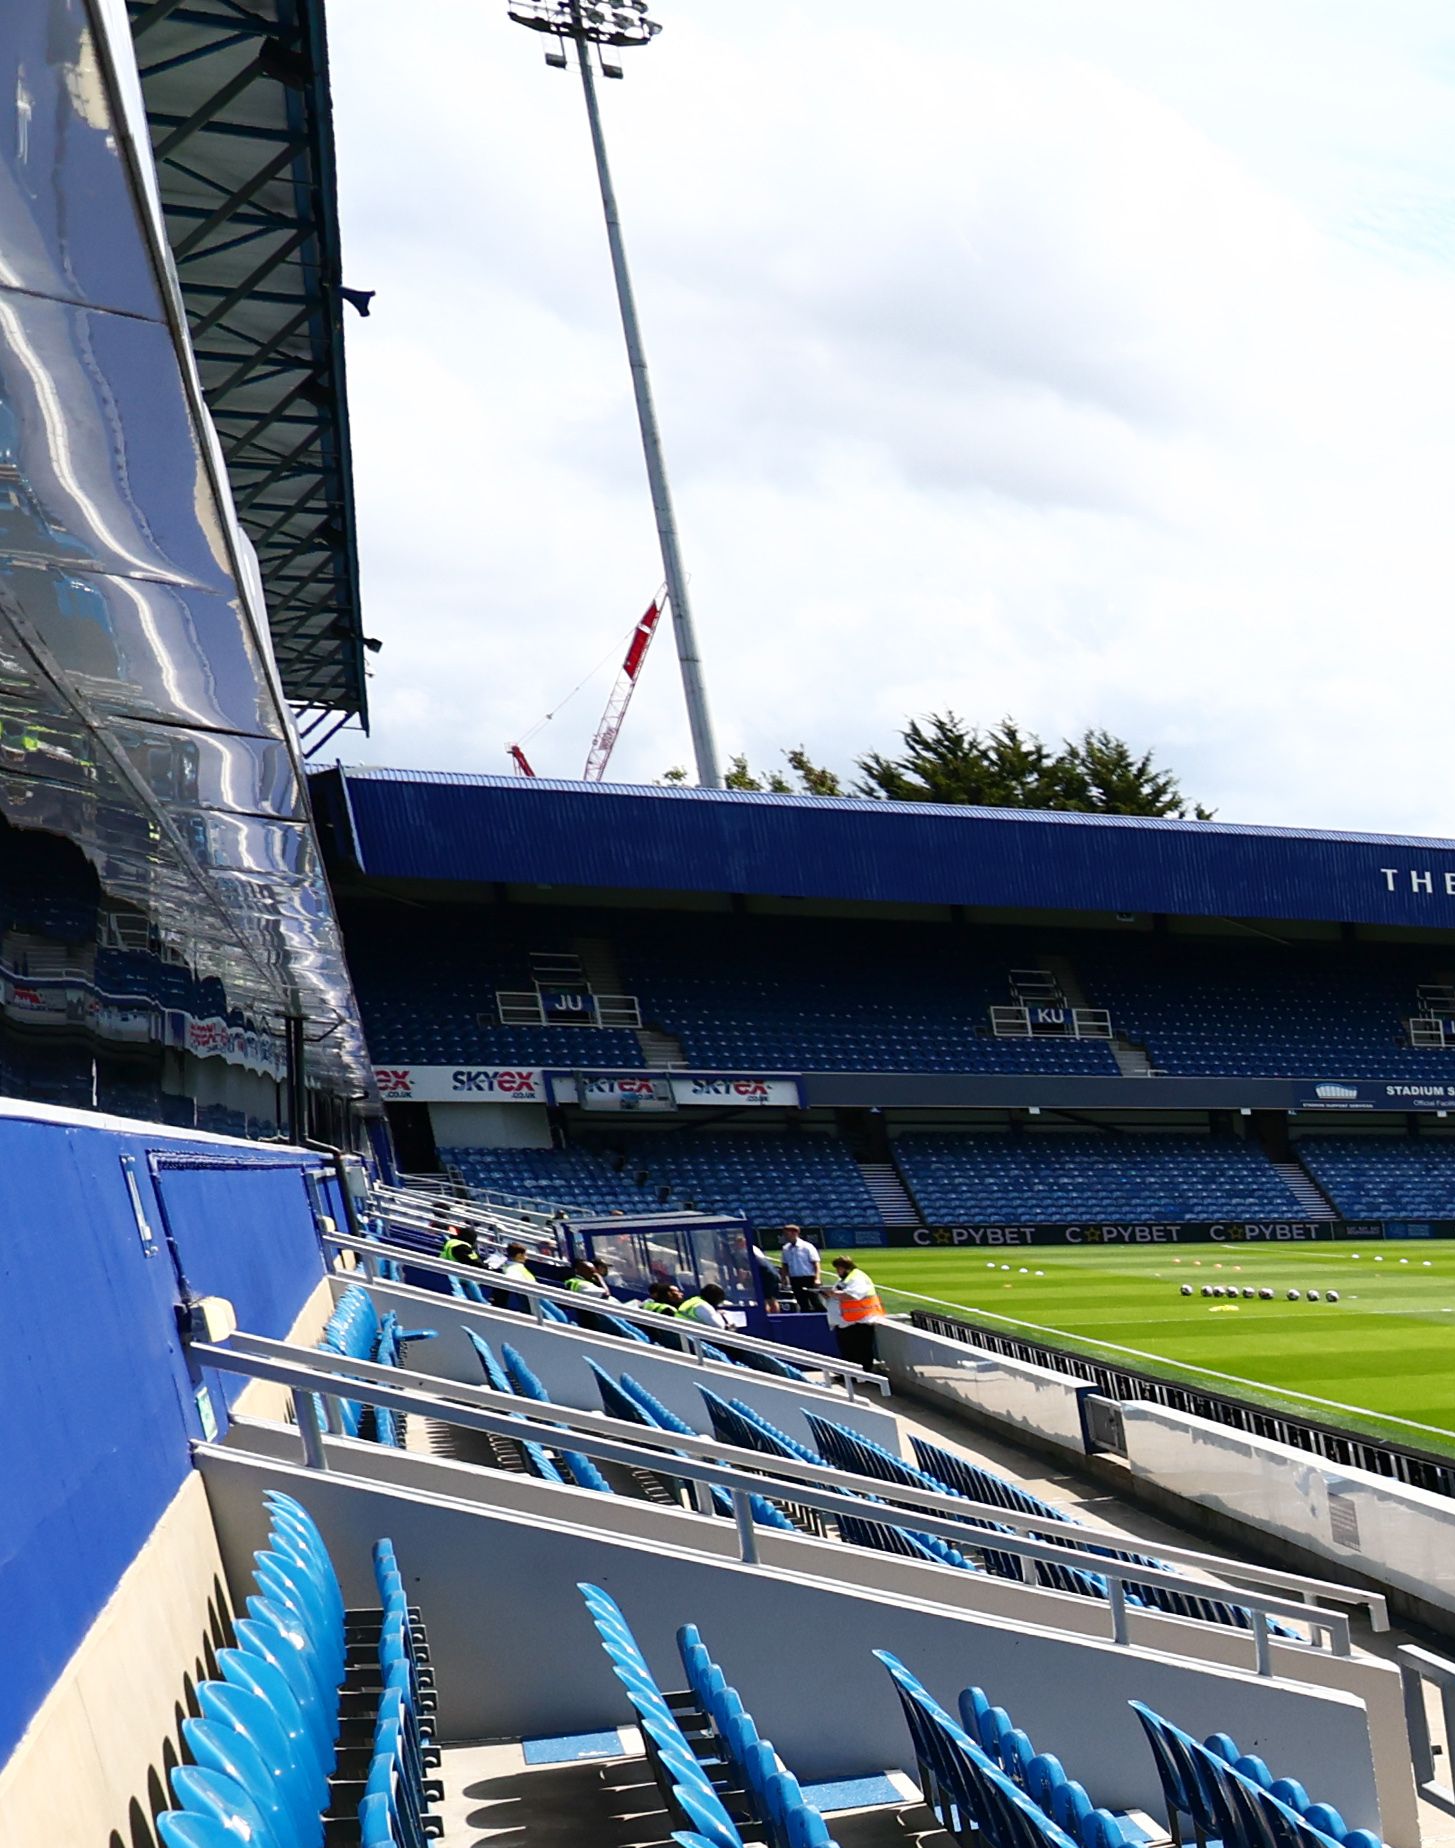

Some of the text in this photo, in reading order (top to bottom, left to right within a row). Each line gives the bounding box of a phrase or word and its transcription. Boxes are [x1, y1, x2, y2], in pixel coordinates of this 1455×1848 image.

[555, 995, 582, 1011] JU
[1037, 1008, 1064, 1023] KU
[1386, 1085, 1444, 1096] STADIUM
